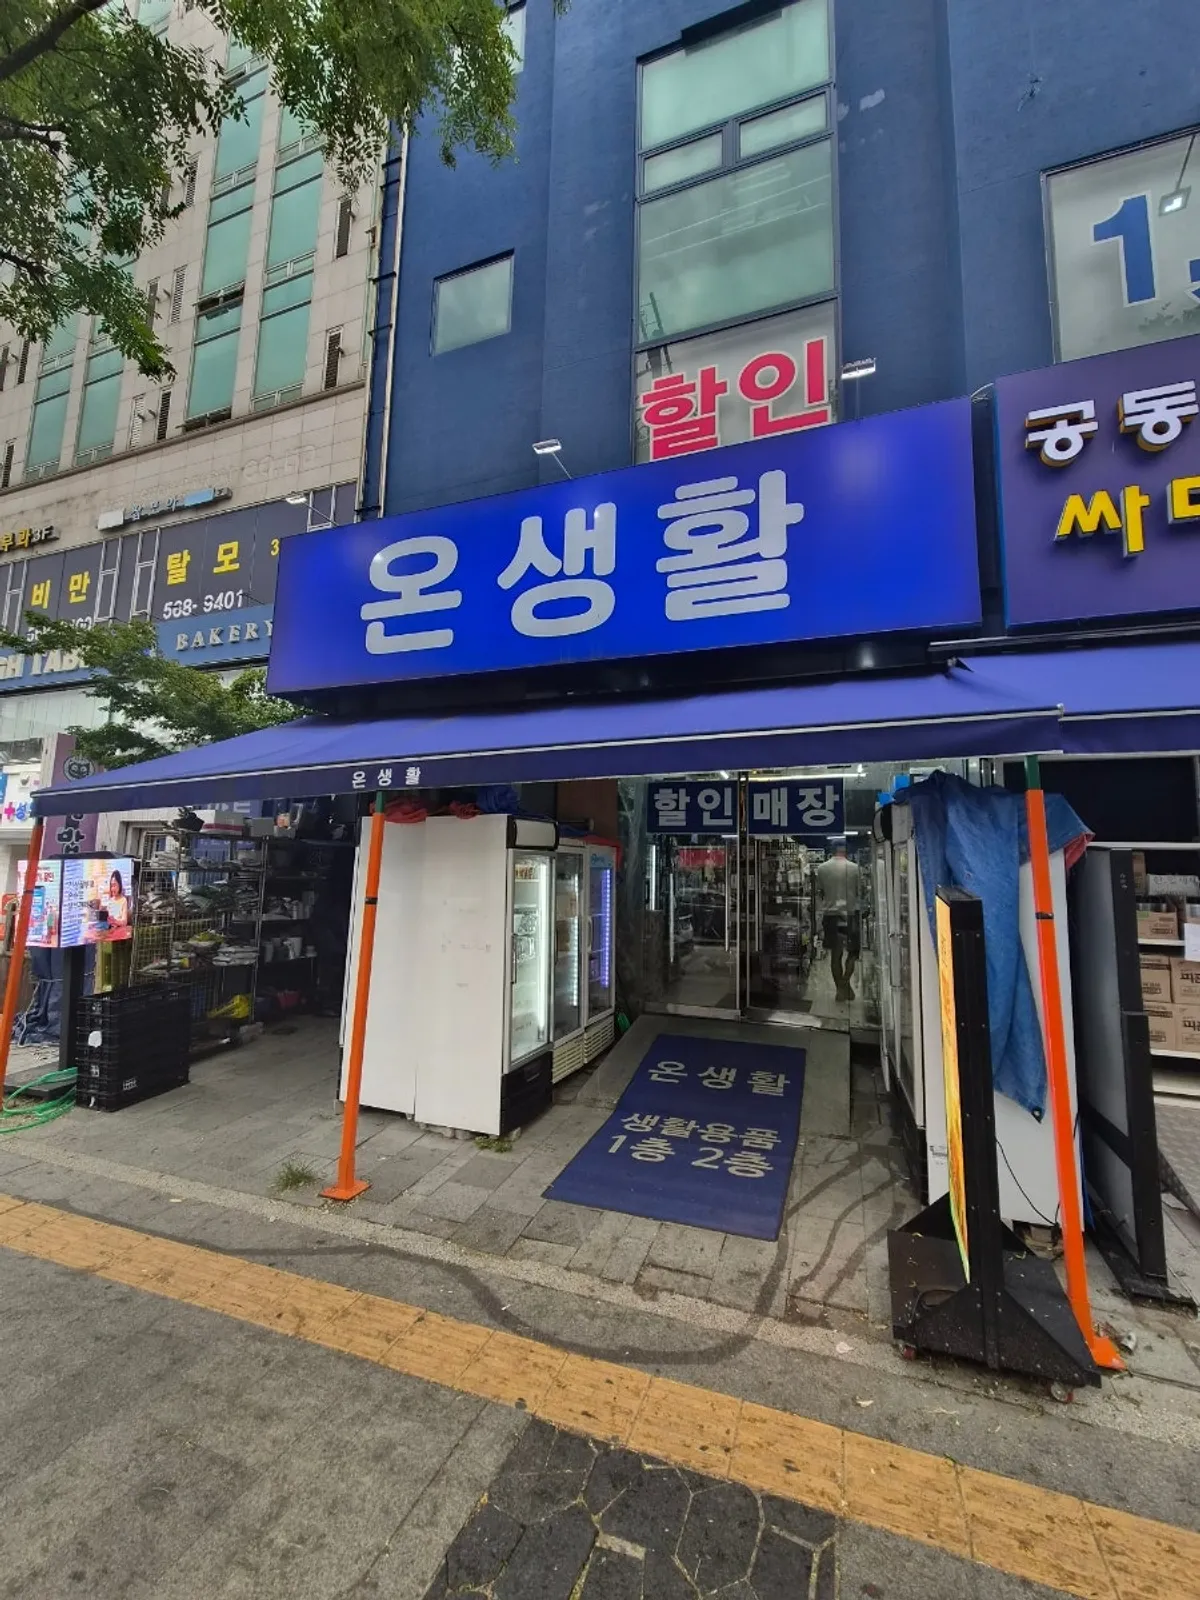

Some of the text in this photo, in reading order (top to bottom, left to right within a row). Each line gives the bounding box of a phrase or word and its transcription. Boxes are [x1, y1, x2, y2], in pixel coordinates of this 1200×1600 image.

[642, 338, 829, 459] 할인
[1025, 380, 1200, 467] 공동
[653, 785, 840, 828] 할인 매장
[621, 1113, 781, 1150] 생활용품
[608, 1134, 774, 1178] 1층 2층
